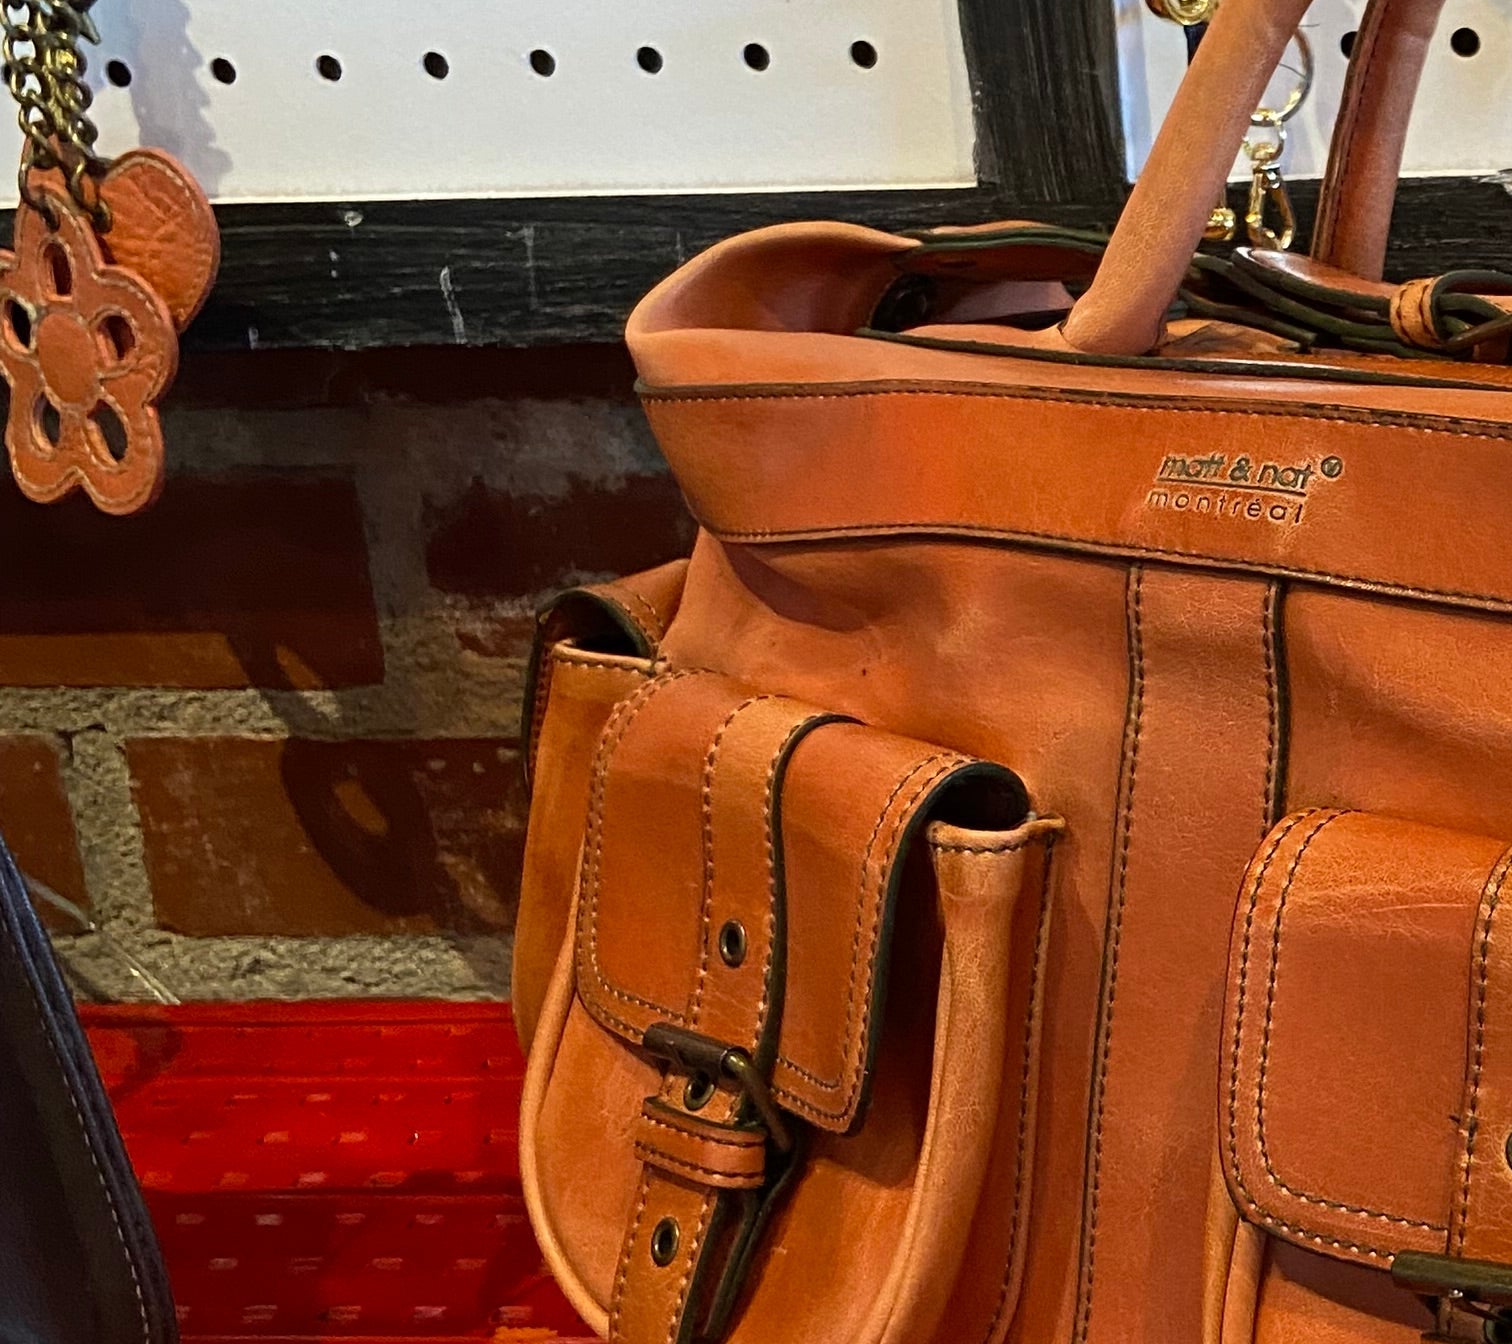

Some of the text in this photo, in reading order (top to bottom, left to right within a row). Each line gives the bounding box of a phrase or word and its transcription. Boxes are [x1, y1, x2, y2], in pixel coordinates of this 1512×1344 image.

[1229, 457, 1250, 482] &
[1257, 462, 1313, 490] nat
[1147, 490, 1304, 524] montréal
